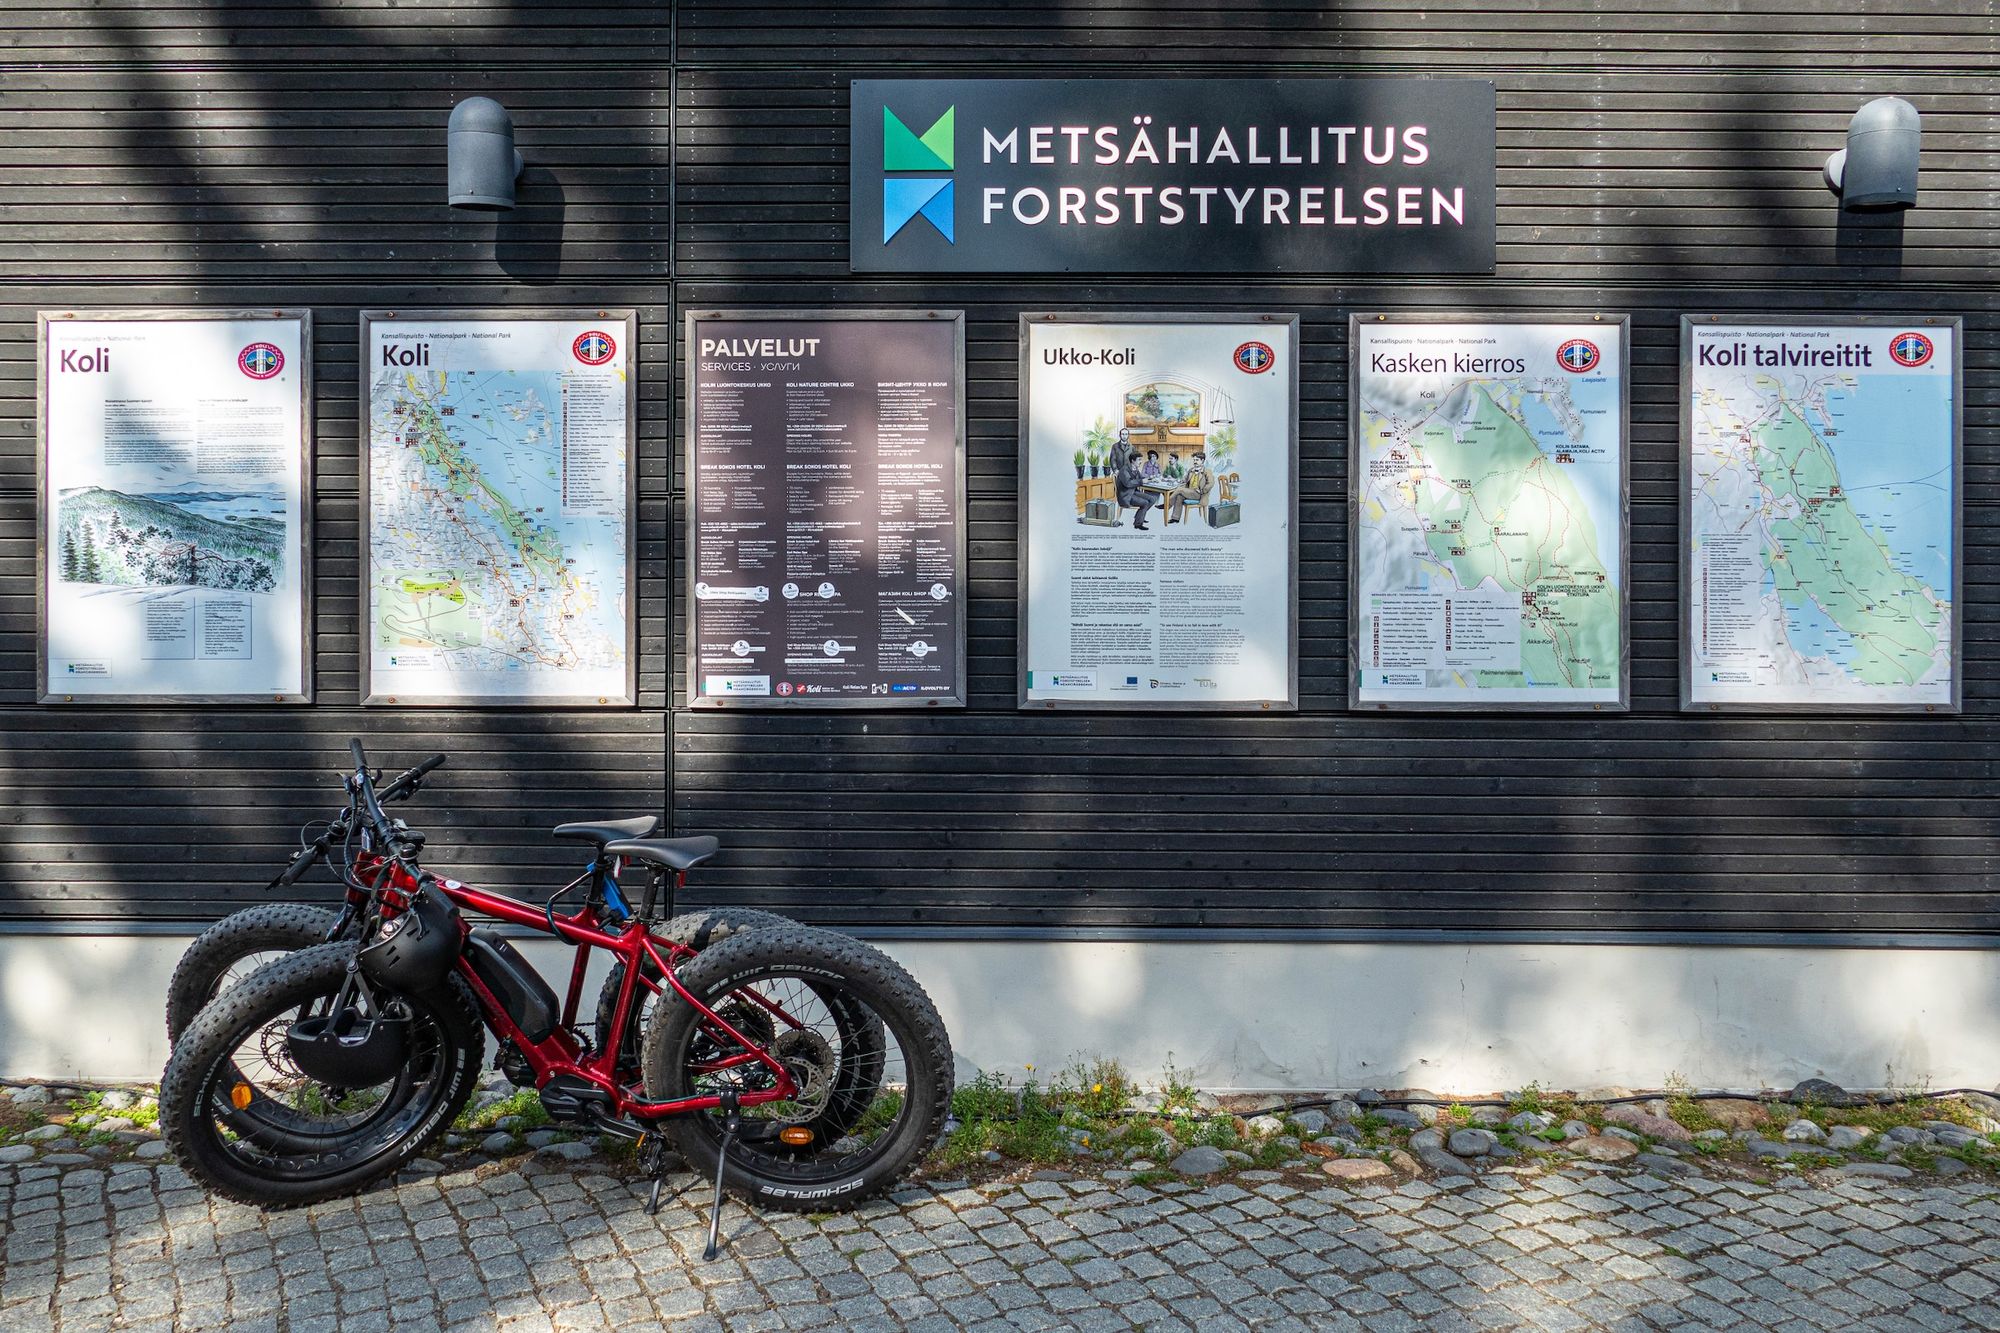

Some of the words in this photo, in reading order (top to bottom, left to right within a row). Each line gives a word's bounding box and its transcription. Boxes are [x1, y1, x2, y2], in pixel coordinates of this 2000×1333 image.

[982, 115, 1430, 167] METSÄHALLITUS
[982, 186, 1466, 227] FORSTSTYRELSEN
[381, 332, 424, 340] Kansallispuisto
[428, 331, 467, 341] Nationalpark
[472, 331, 497, 339] National
[499, 331, 511, 339] Park
[1698, 331, 1741, 339] Kansallispuisto
[382, 344, 430, 367] Koli
[701, 338, 820, 357] PALVELUT
[1043, 347, 1136, 366] Ukko-Koli
[1699, 343, 1746, 367] Koli
[1754, 343, 1872, 367] talvireitit
[60, 347, 110, 373] Koli
[701, 362, 751, 372] SERVICES
[760, 362, 800, 372] УСЛУГИ
[1371, 353, 1446, 373] Kasken
[1454, 352, 1525, 373] kierros
[1420, 390, 1436, 399] Koli
[806, 684, 822, 693] Koli
[760, 1177, 864, 1200] SCHWALBE
